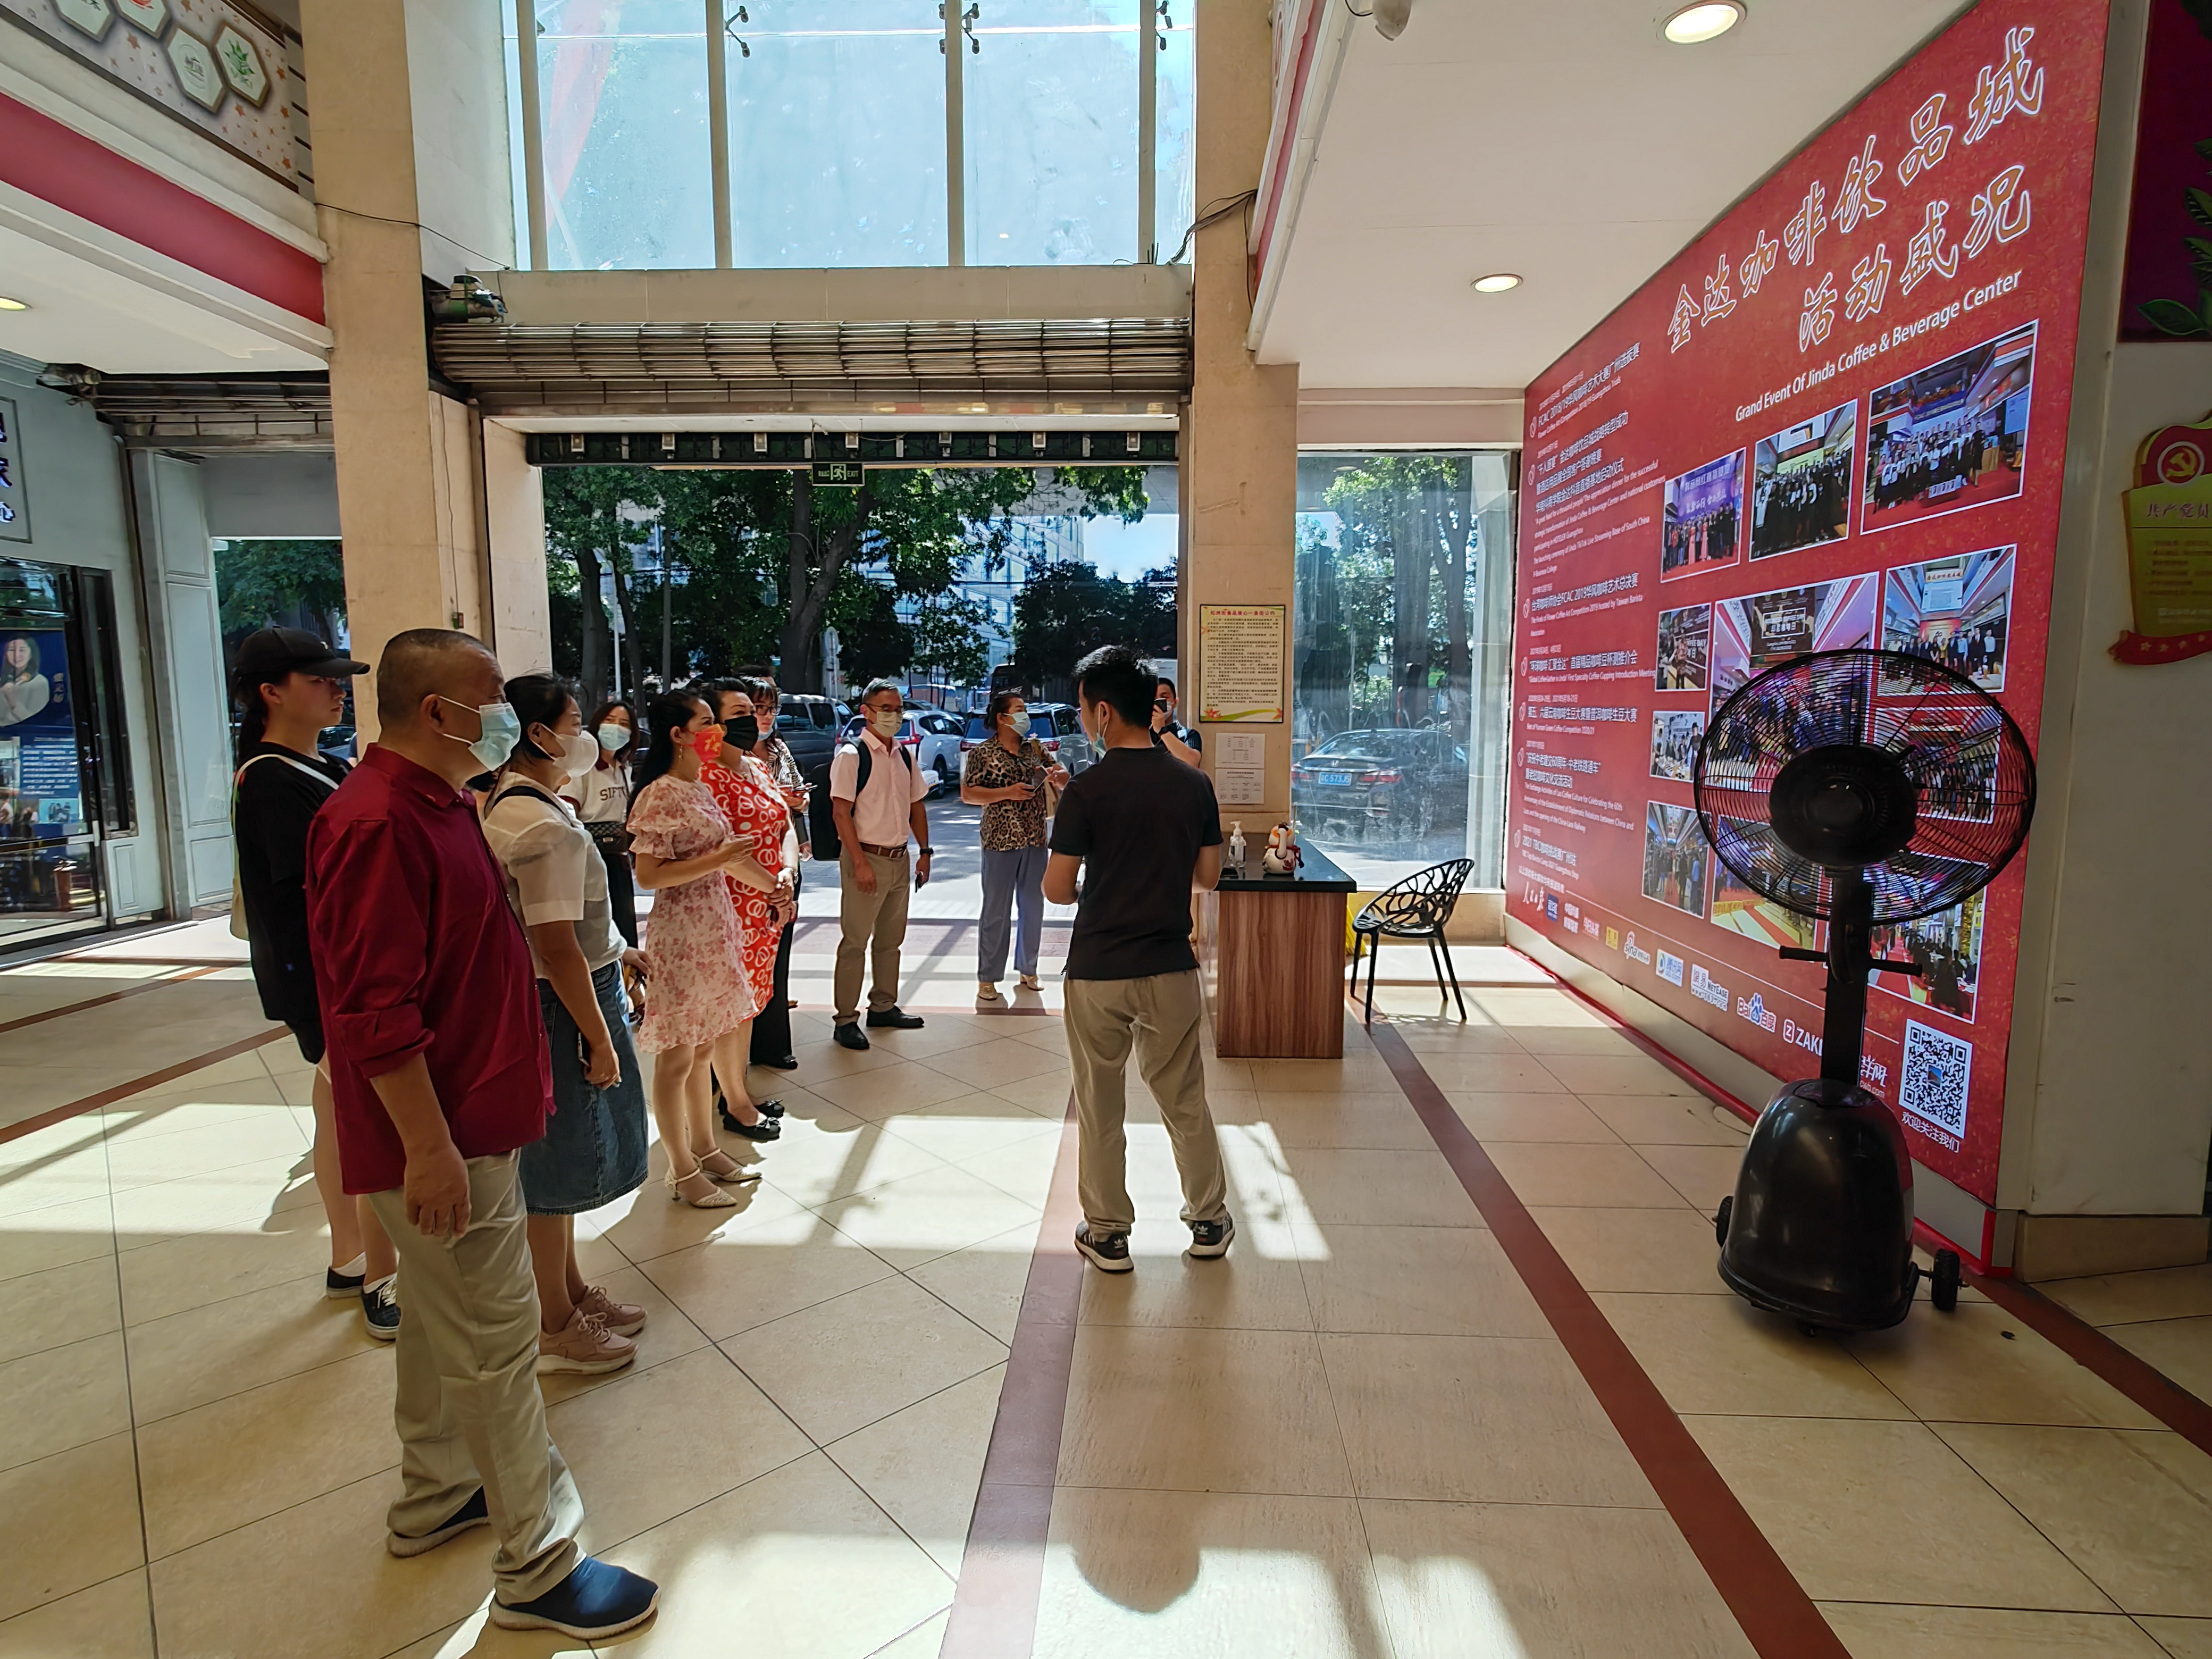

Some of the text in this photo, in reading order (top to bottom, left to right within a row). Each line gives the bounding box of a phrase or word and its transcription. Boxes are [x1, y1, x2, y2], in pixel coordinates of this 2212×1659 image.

[1736, 269, 2023, 422] Grand Event Of Jinda Coffee & Beverage Center
[1637, 459, 1657, 477] successful
[1644, 474, 1665, 491] customers
[1626, 519, 1637, 531] South
[1638, 514, 1649, 526] China
[1615, 669, 1638, 678] Introduction
[1638, 668, 1655, 680] Meeting
[1522, 835, 1532, 848] 2021
[1901, 1110, 1961, 1153] 欢迎关注我们
